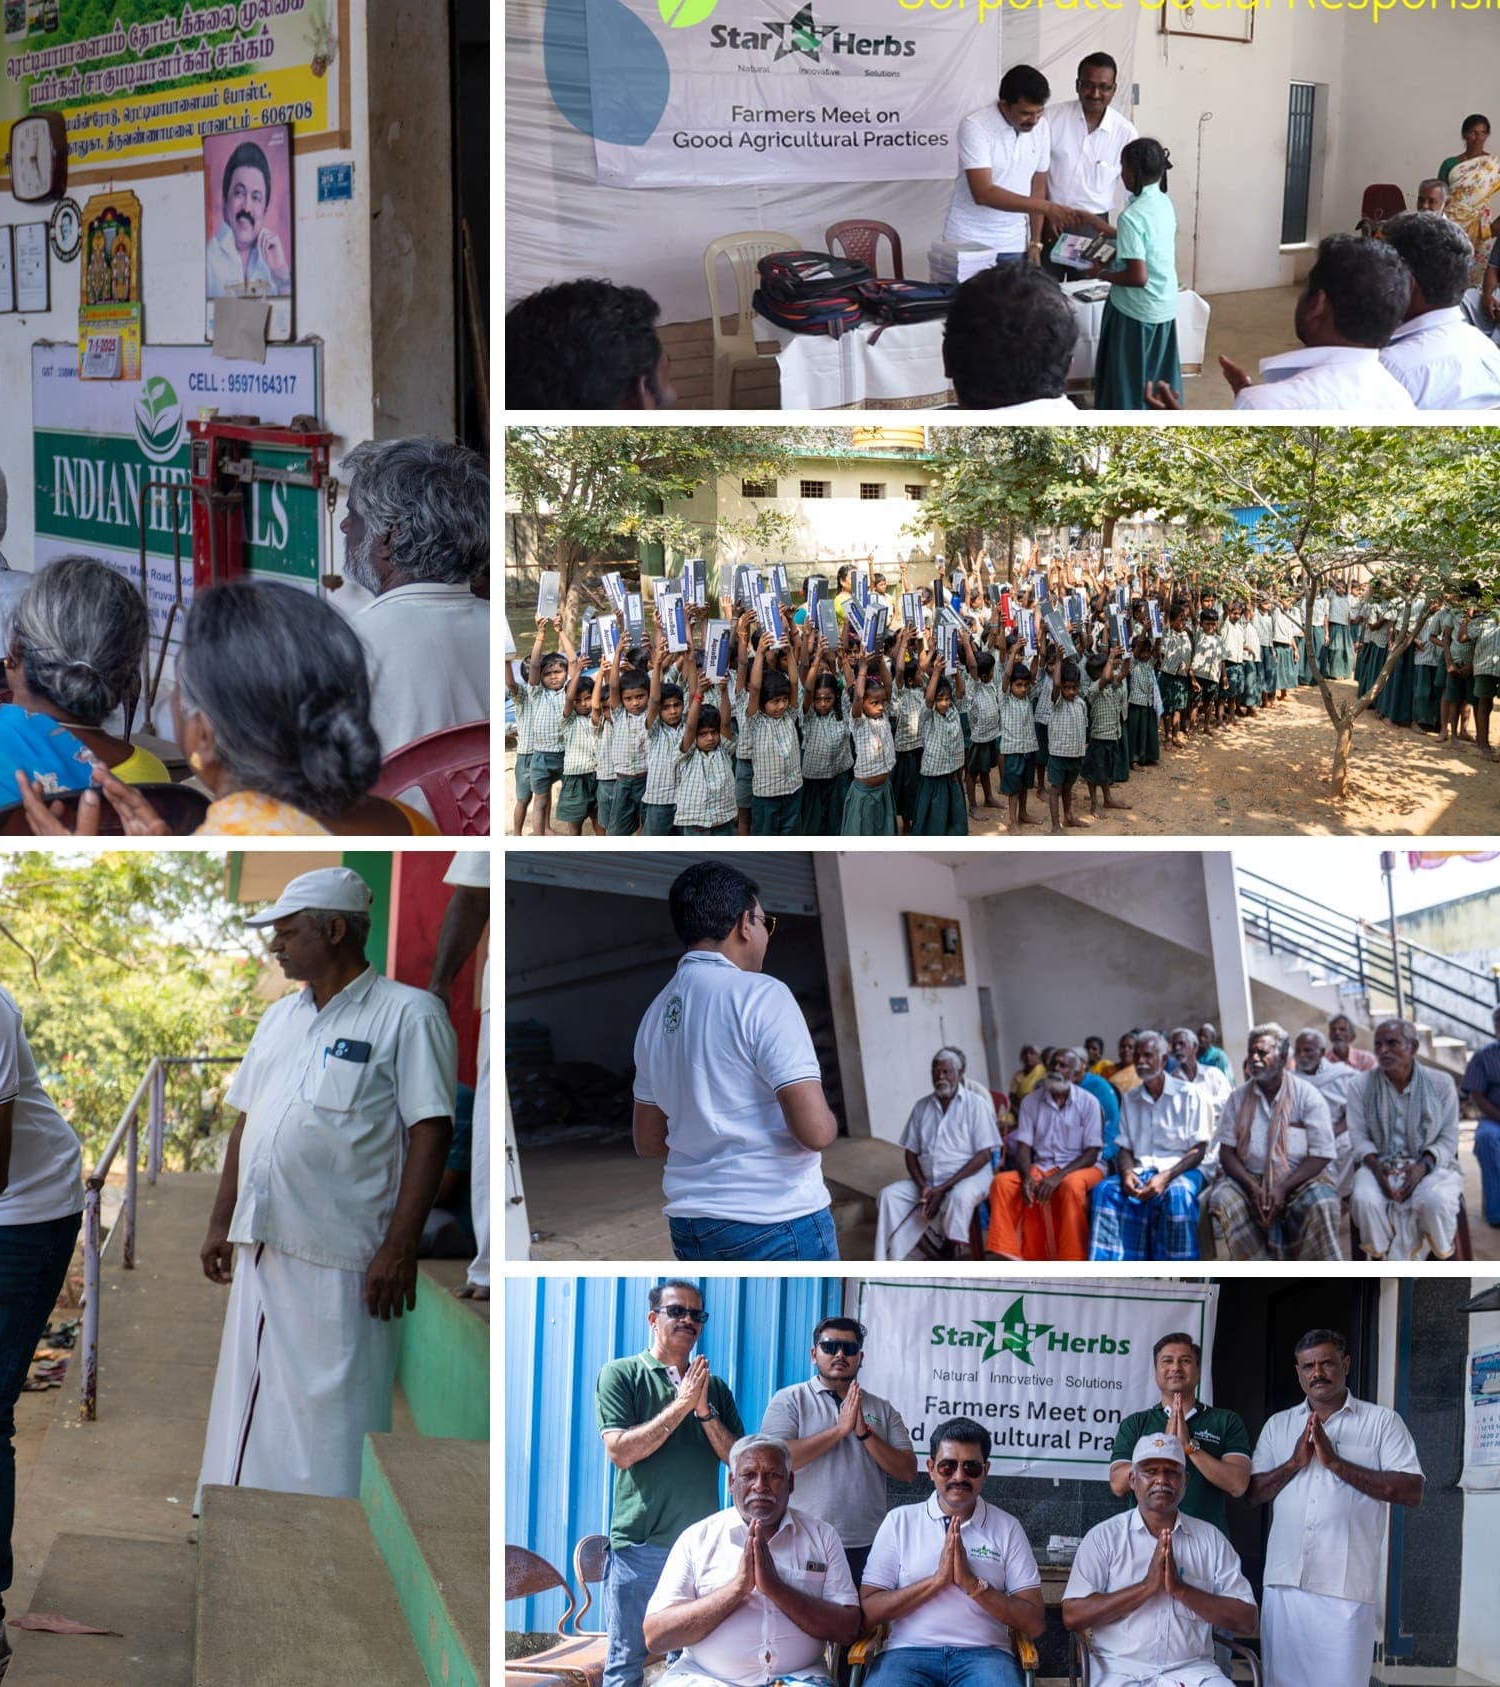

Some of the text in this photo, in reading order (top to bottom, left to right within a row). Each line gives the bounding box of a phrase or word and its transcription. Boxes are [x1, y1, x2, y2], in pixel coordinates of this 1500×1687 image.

[710, 25, 772, 50] Star
[832, 32, 916, 57] Herbs
[738, 65, 900, 78] Natural Innovative Solutions
[261, 101, 313, 125] 606708
[731, 105, 900, 123] Farmers Meet on
[673, 131, 948, 152] Good Agricultural Practices
[188, 373, 219, 392] CELL
[228, 375, 297, 394] 9597164317
[52, 455, 142, 526] INDIAN
[150, 568, 174, 584] Road,
[668, 607, 676, 636] AquaBot
[604, 629, 613, 654] AquaBot
[710, 638, 719, 667] AquaBot
[930, 1324, 988, 1348] Star
[1047, 1331, 1131, 1355] Herbs
[932, 1369, 1123, 1390] Natural Innovative Solutions
[925, 1395, 1121, 1424] Farmers Meet on
